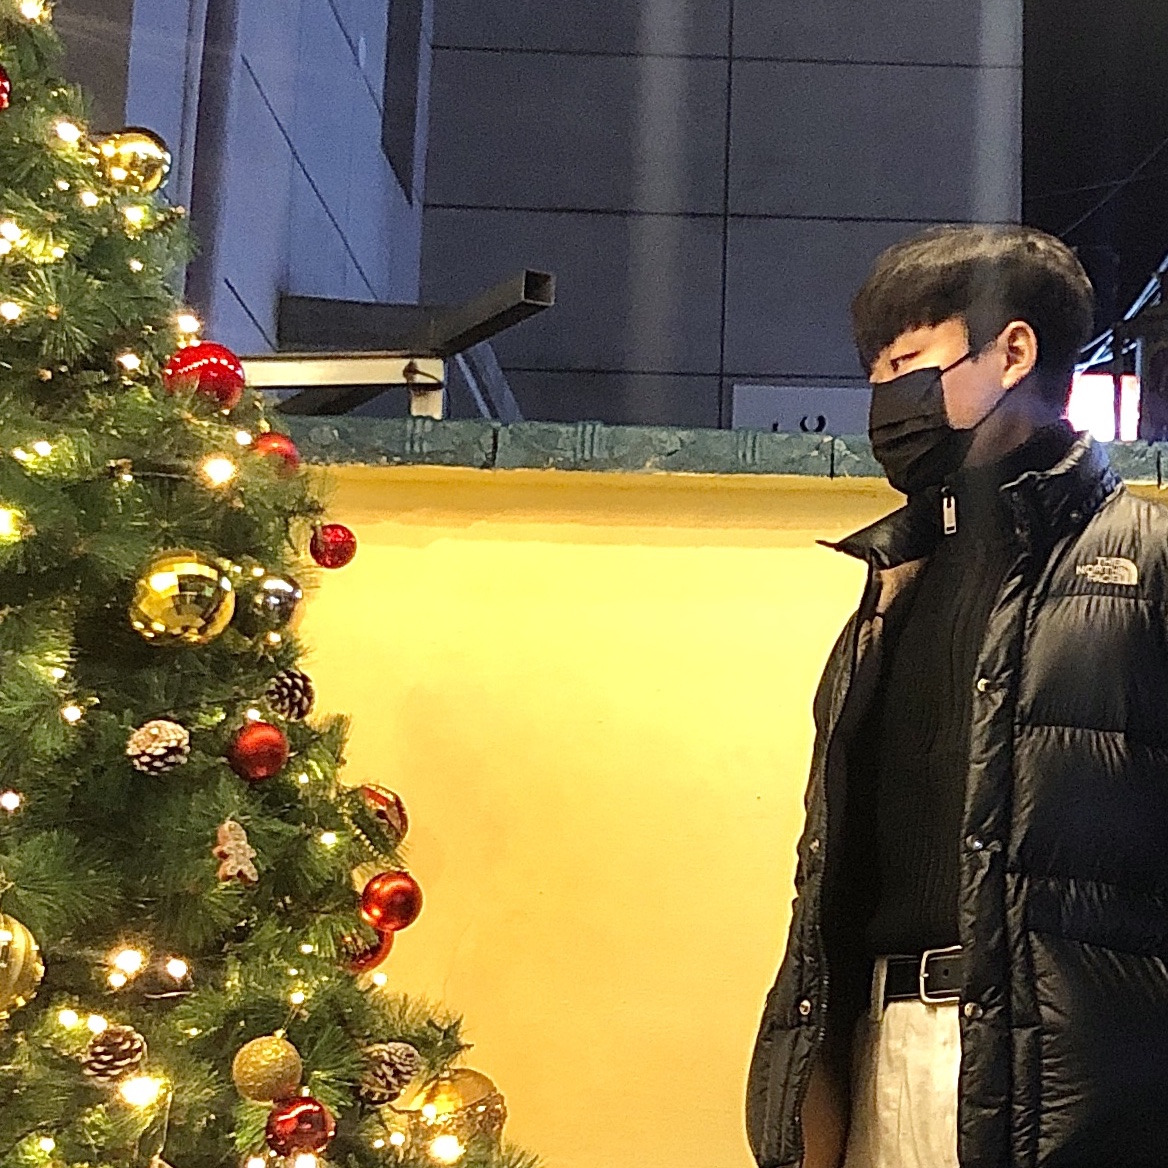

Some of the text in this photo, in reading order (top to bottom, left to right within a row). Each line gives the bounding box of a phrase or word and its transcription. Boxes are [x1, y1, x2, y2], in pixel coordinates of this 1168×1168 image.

[1096, 556, 1121, 567] THE
[1075, 564, 1119, 575] NORTH
[1087, 573, 1120, 584] FACE
